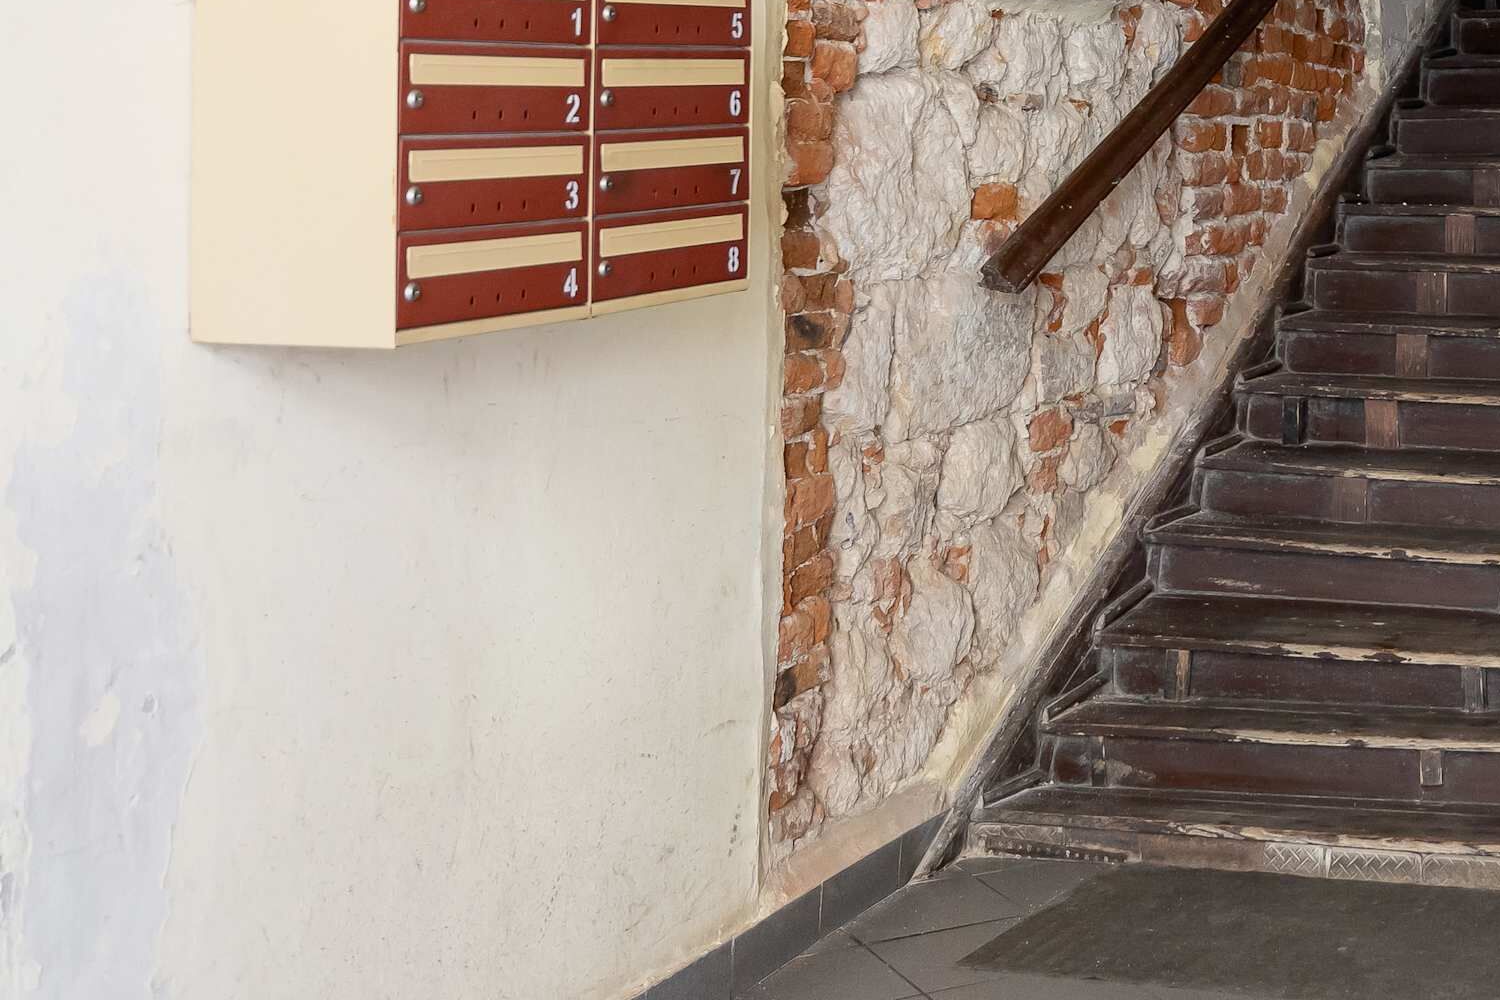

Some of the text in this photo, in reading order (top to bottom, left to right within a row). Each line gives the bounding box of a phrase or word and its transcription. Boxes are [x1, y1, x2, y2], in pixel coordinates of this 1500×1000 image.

[570, 7, 582, 36] 1
[731, 12, 743, 39] 5
[565, 93, 581, 124] 2
[729, 90, 741, 117] 6
[565, 180, 580, 210] 3
[730, 168, 741, 195] 7
[727, 246, 740, 273] 8
[562, 267, 579, 298] 4
